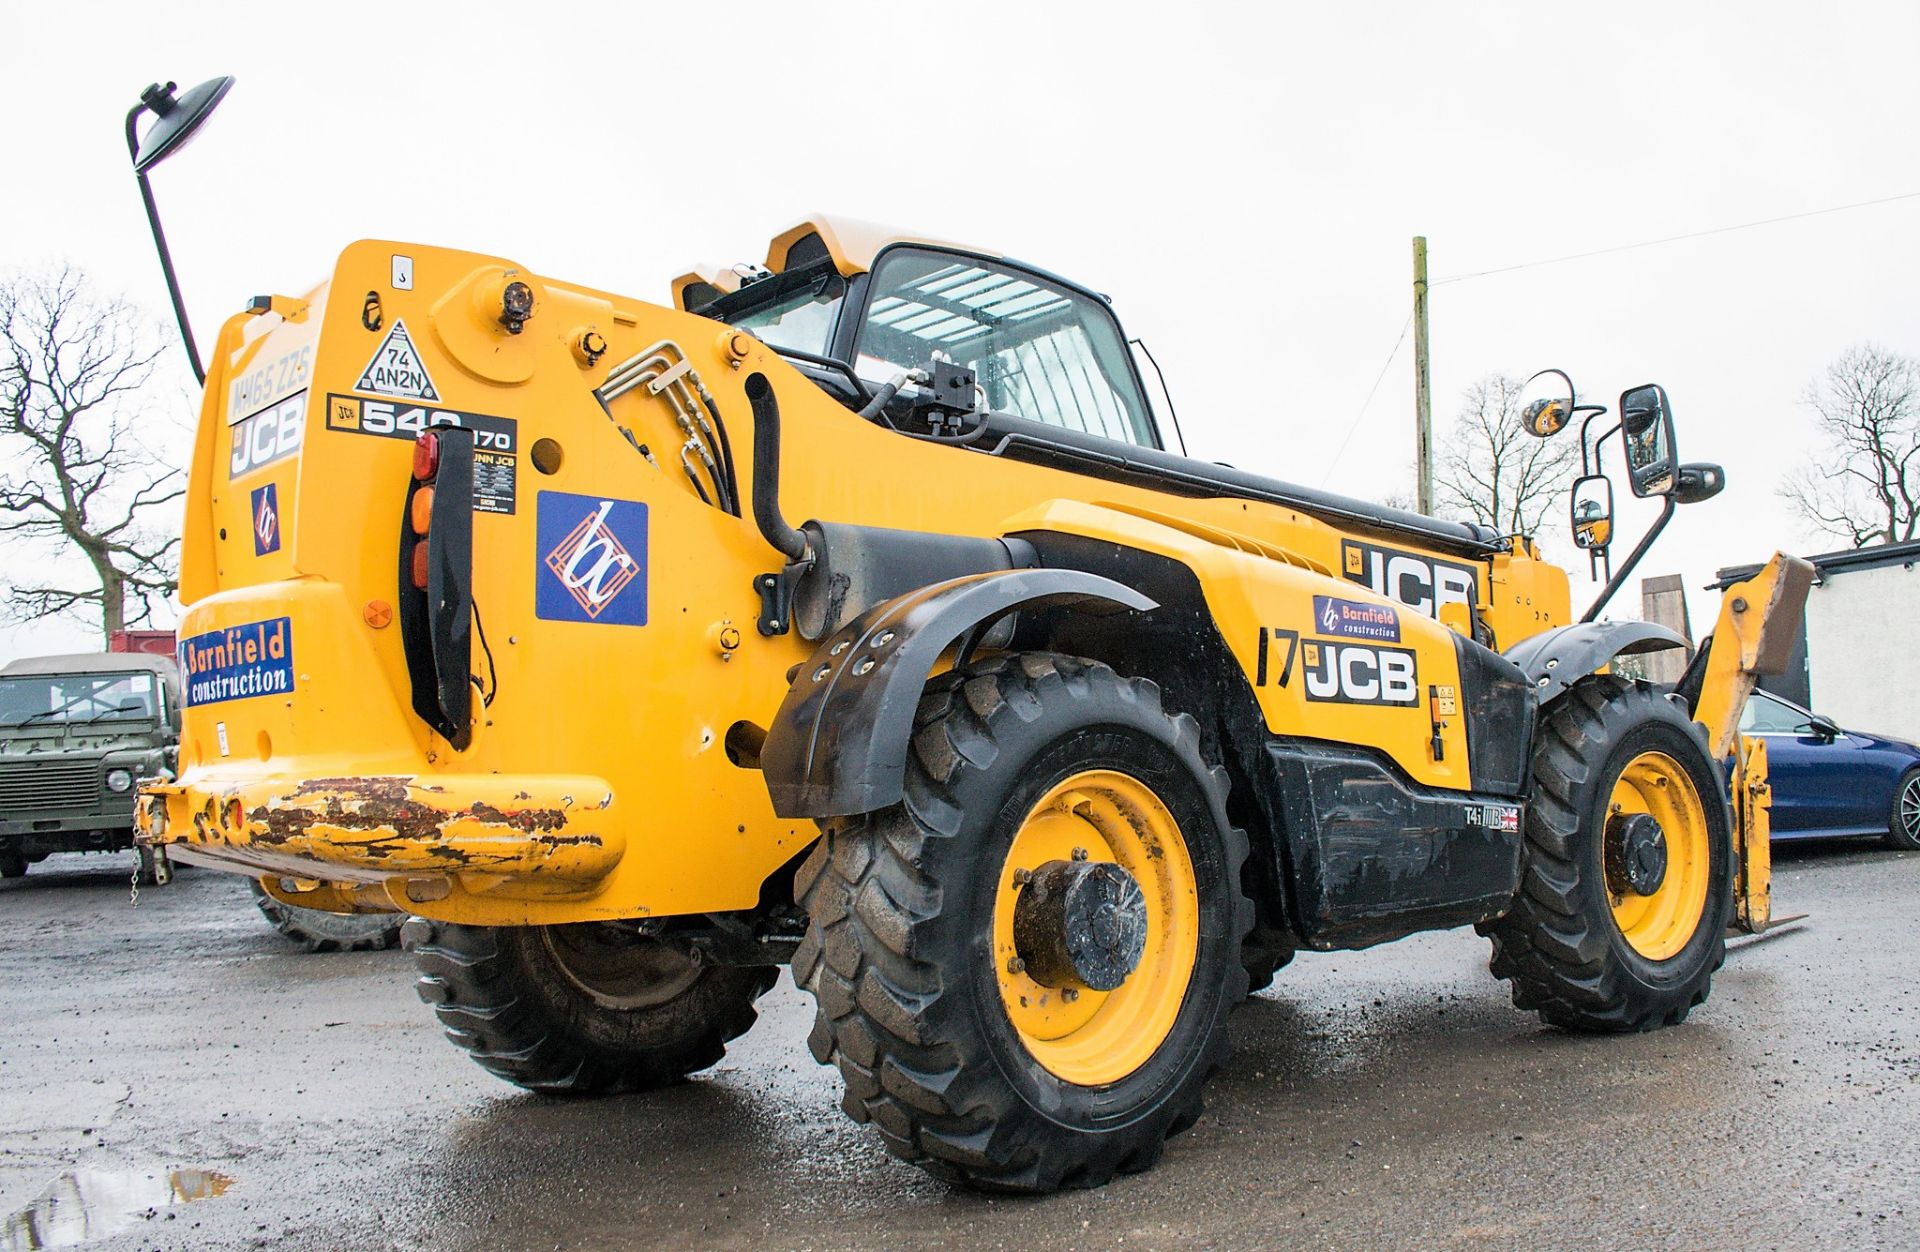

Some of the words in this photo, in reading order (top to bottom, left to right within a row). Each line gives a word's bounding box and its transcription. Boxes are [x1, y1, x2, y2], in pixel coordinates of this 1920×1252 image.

[388, 348, 409, 368] 74
[375, 367, 422, 391] AN2N
[231, 397, 304, 474] JCB
[473, 430, 511, 449] 170
[495, 457, 515, 467] JCB
[1342, 605, 1395, 625] Barnfield
[1344, 624, 1395, 638] construction
[188, 621, 285, 674] Barnfield
[192, 665, 287, 703] construction
[1306, 645, 1417, 702] JCB
